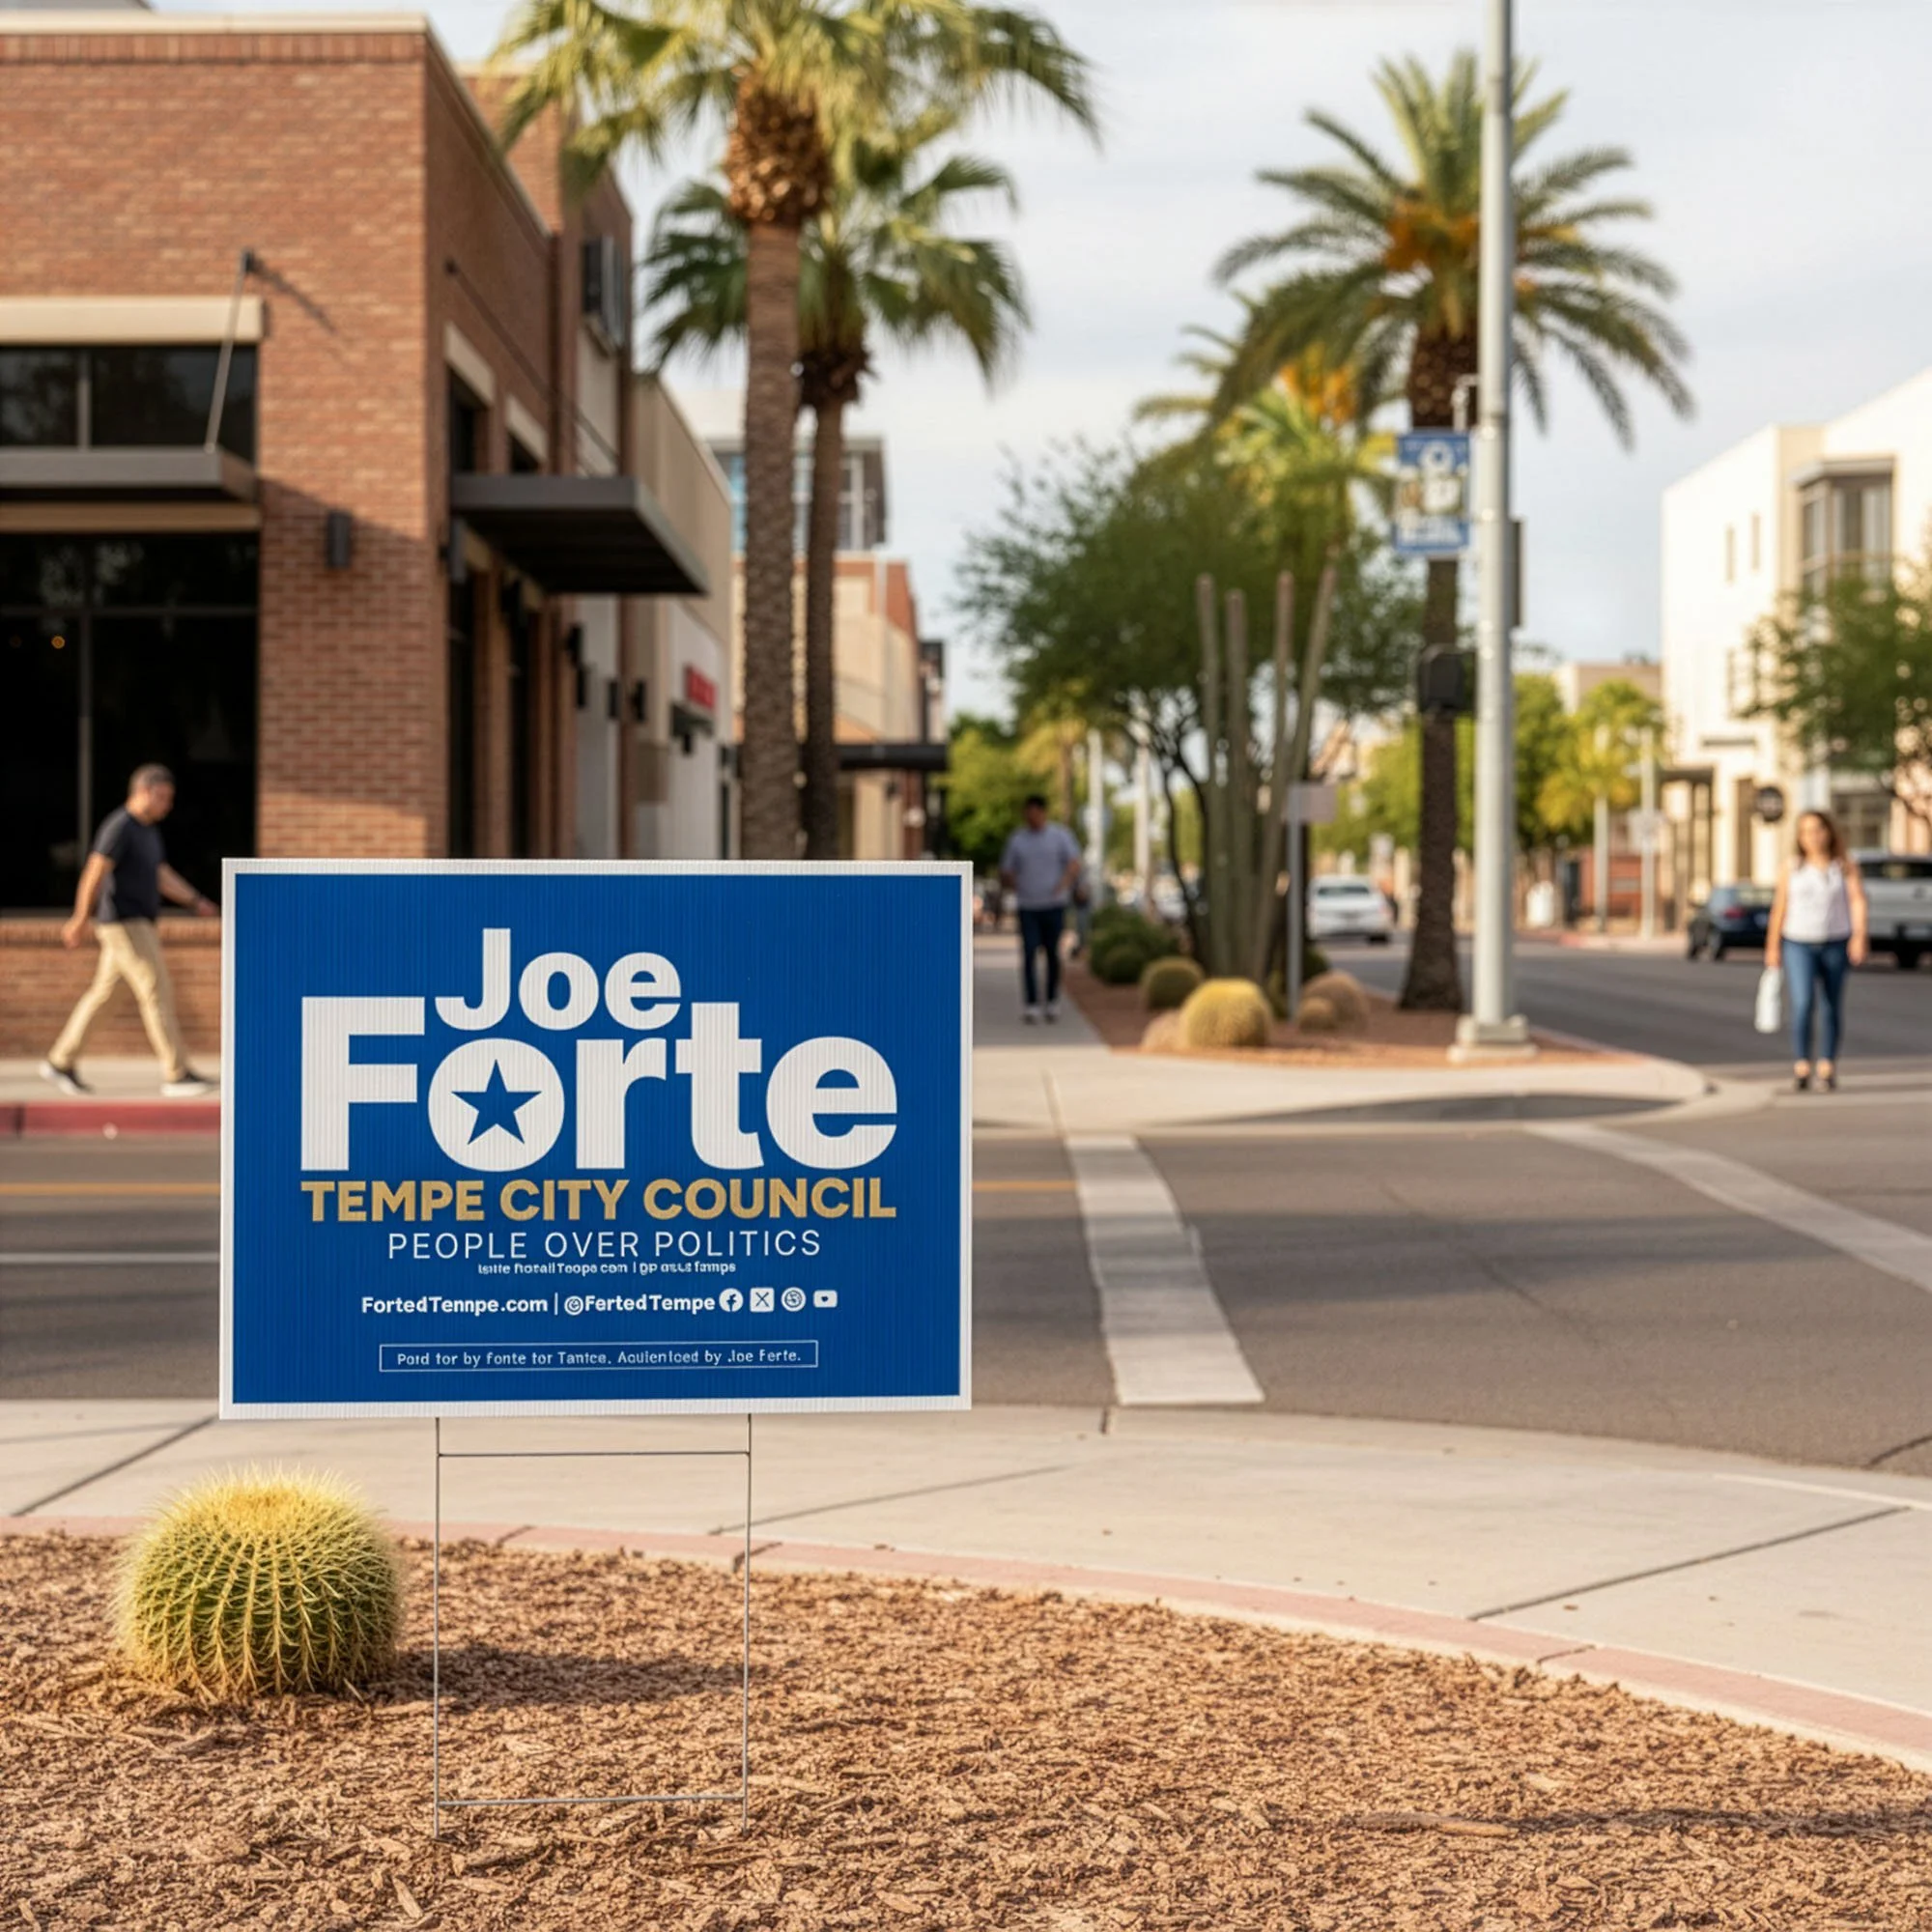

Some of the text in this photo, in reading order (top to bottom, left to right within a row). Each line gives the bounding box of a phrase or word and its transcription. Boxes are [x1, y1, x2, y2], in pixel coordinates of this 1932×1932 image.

[434, 927, 681, 1031] Joe
[300, 996, 898, 1173] Forte
[300, 1178, 896, 1223] TEMPE CITY COUNCIL
[388, 1229, 821, 1260] PEOPLE OVER POLITICS
[463, 1351, 481, 1369] by
[704, 1350, 723, 1366] by
